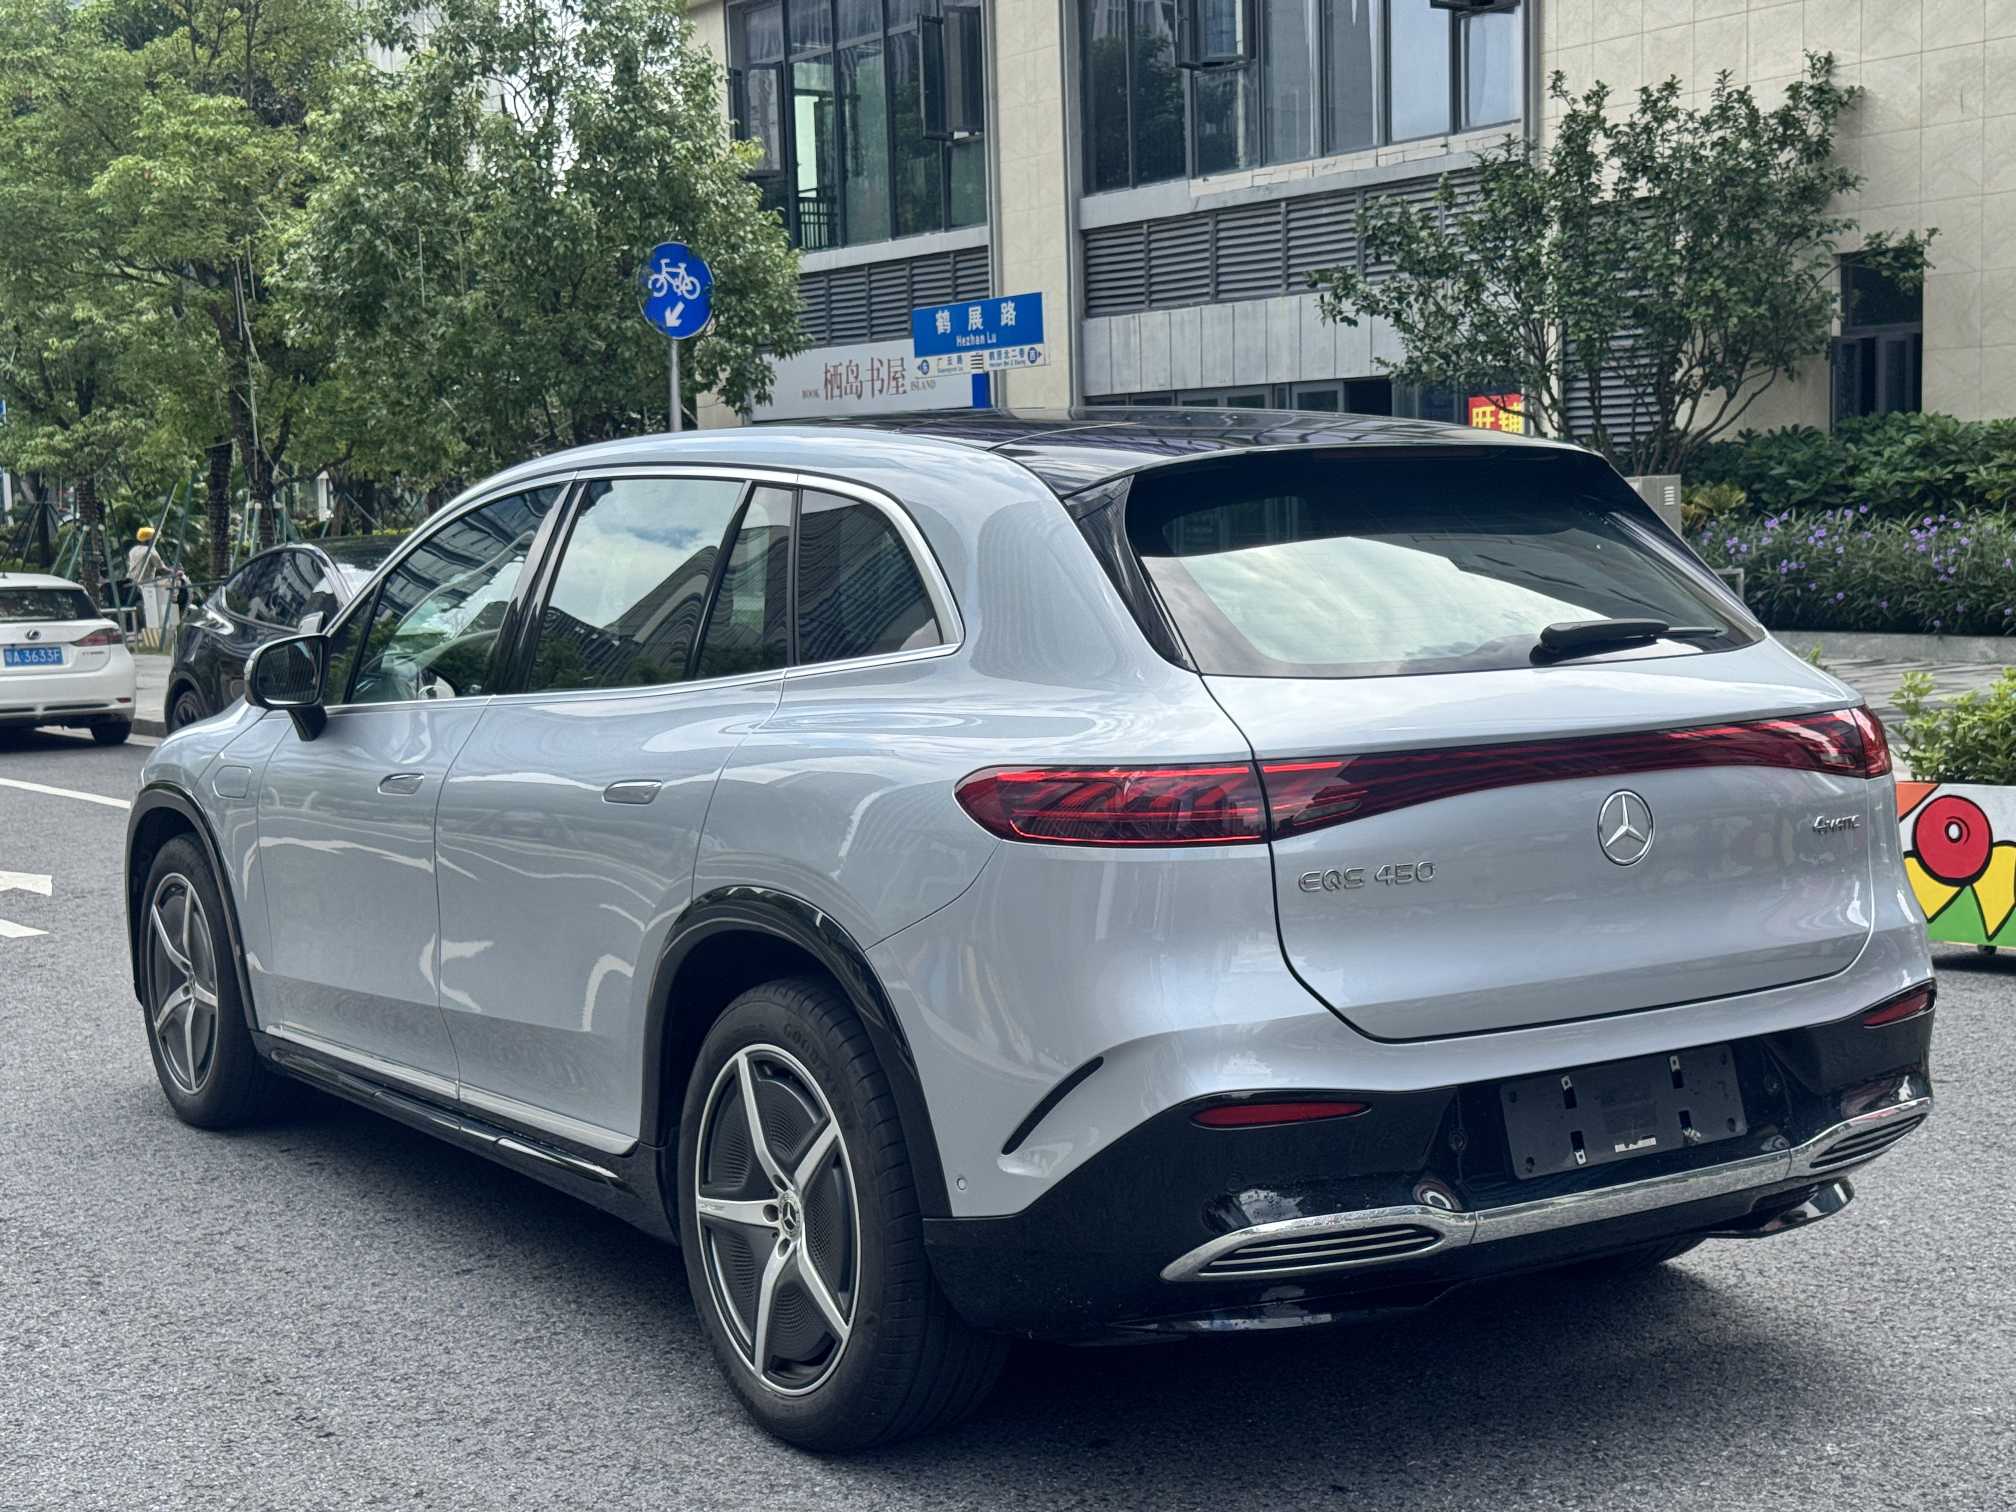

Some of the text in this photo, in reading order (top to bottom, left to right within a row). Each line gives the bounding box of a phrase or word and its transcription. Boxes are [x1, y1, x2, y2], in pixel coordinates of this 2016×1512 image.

[935, 301, 1017, 335] 鹤展路
[956, 331, 997, 347] Hezhan Lu
[824, 356, 907, 401] 栖岛书屋
[1299, 860, 1436, 893] EQS 450
